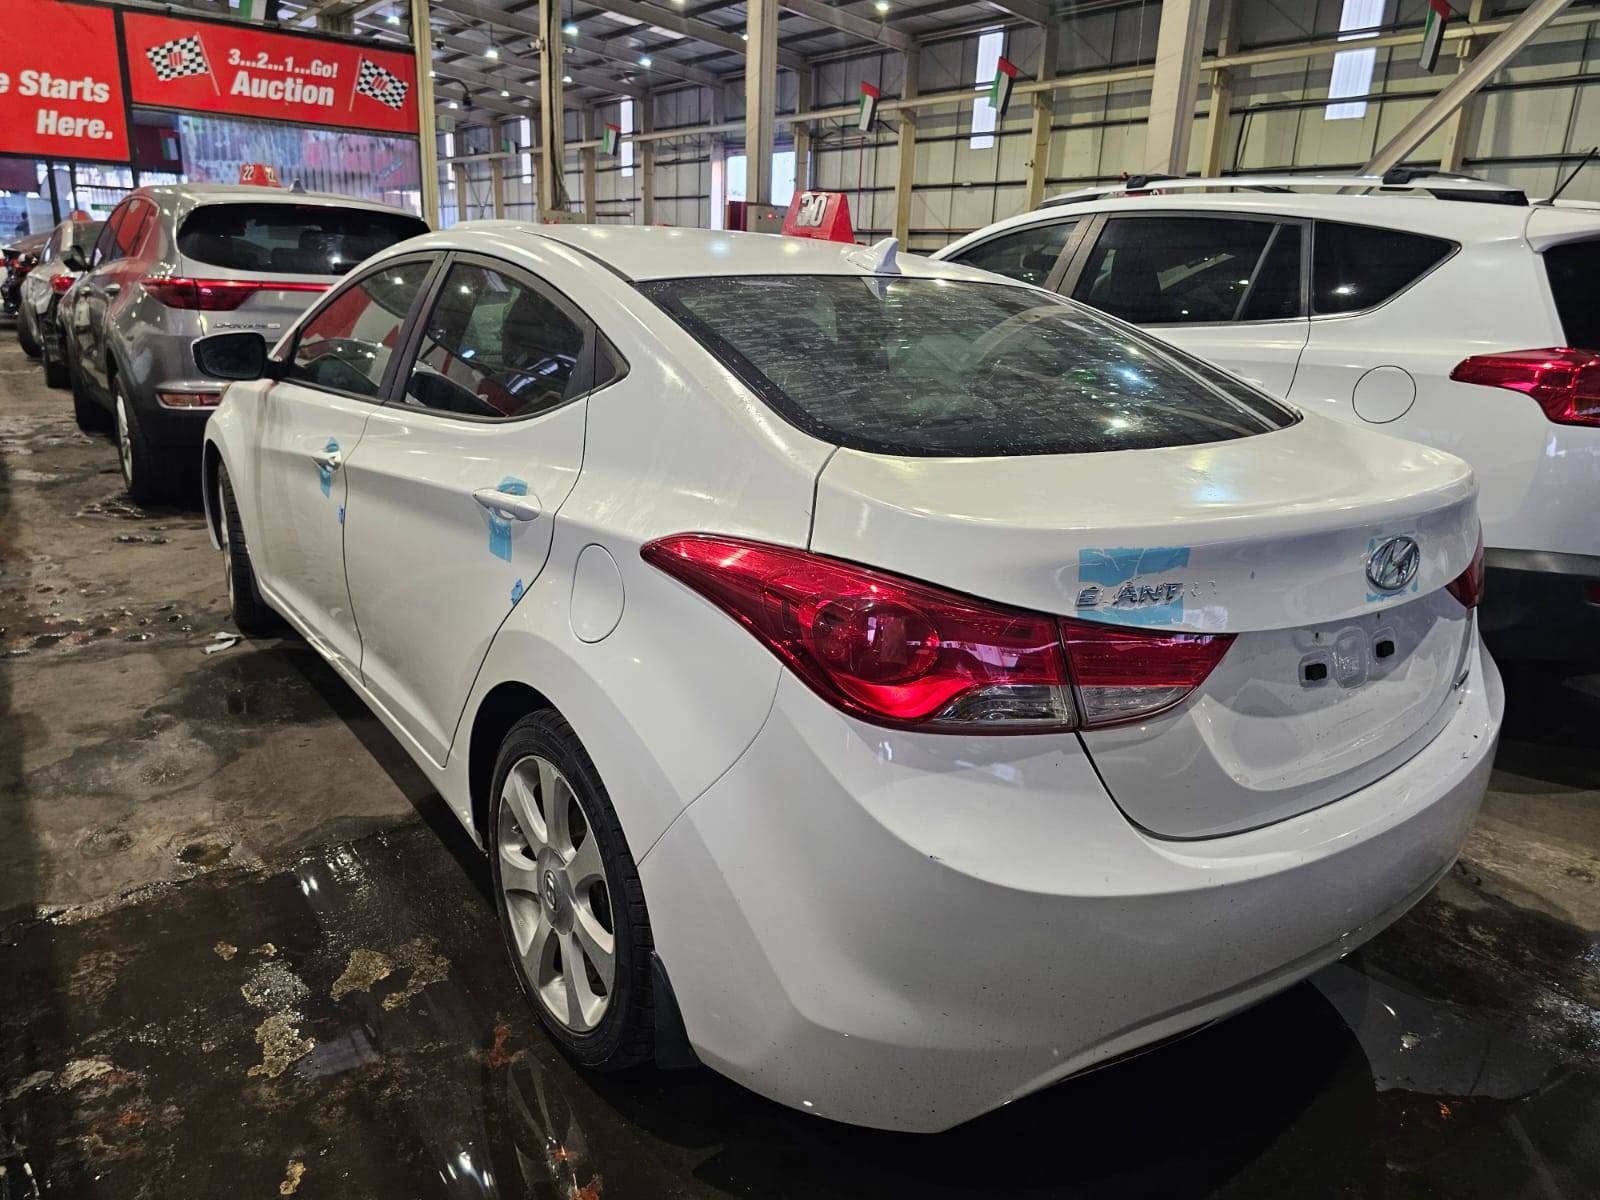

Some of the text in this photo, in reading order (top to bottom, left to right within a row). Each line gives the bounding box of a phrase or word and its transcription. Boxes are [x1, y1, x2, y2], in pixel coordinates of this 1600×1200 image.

[18, 69, 110, 103] Starts
[230, 70, 334, 106] Auction
[36, 108, 113, 139] Here.
[243, 163, 255, 181] 22
[1076, 580, 1216, 609] EANT
